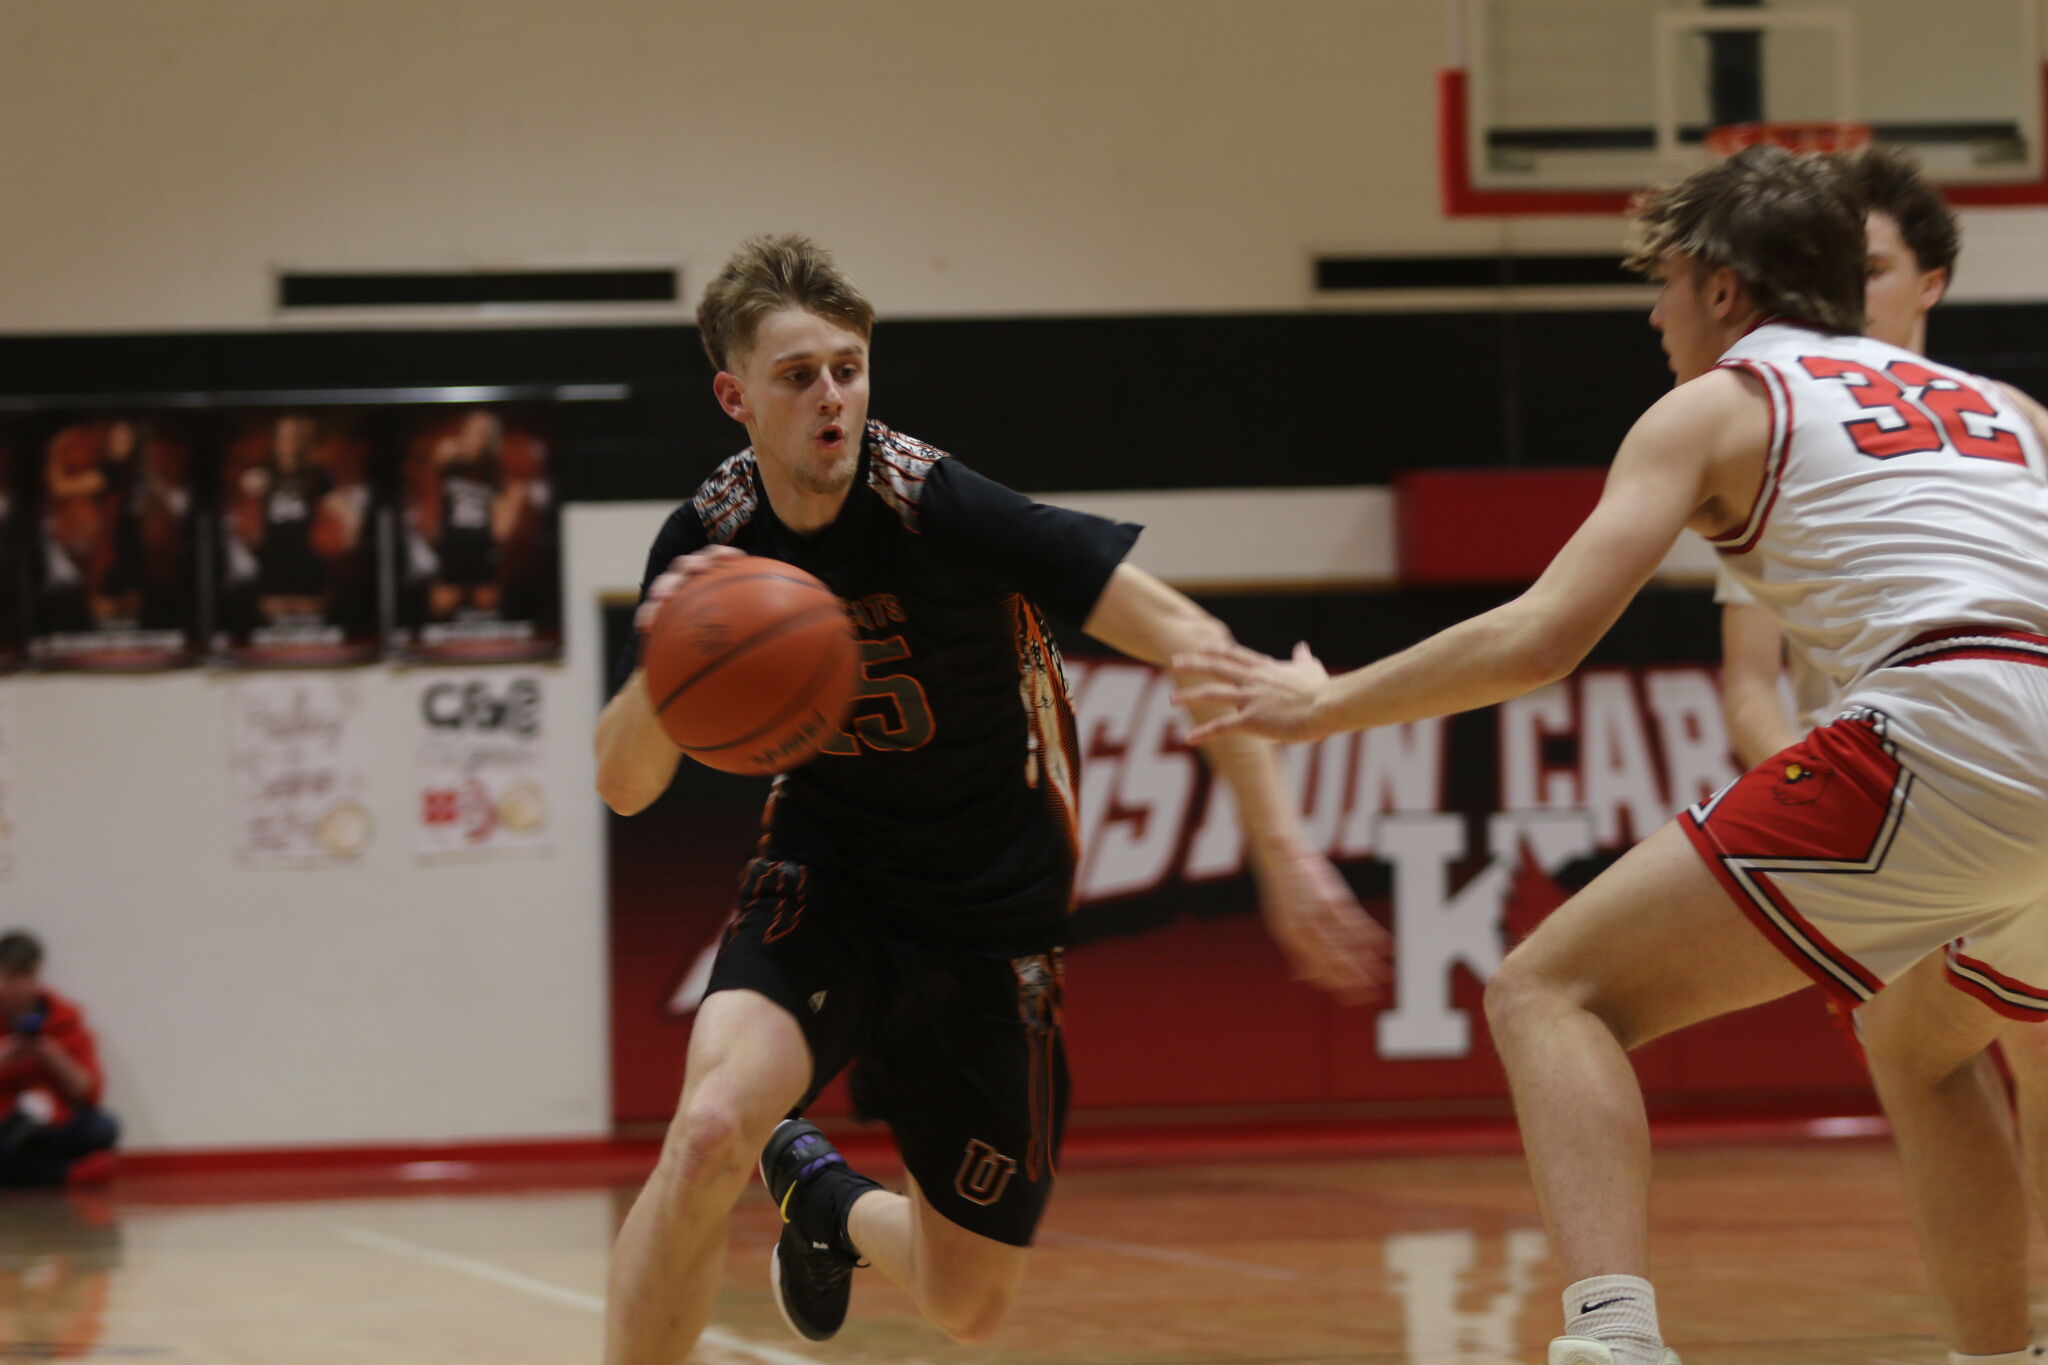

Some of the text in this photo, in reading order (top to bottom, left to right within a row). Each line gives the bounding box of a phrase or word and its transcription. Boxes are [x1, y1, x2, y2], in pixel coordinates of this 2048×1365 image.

[1797, 355, 2028, 468] 32
[1502, 667, 1742, 842] CAR
[1376, 812, 1594, 1058] K
[954, 1138, 1017, 1206] U
